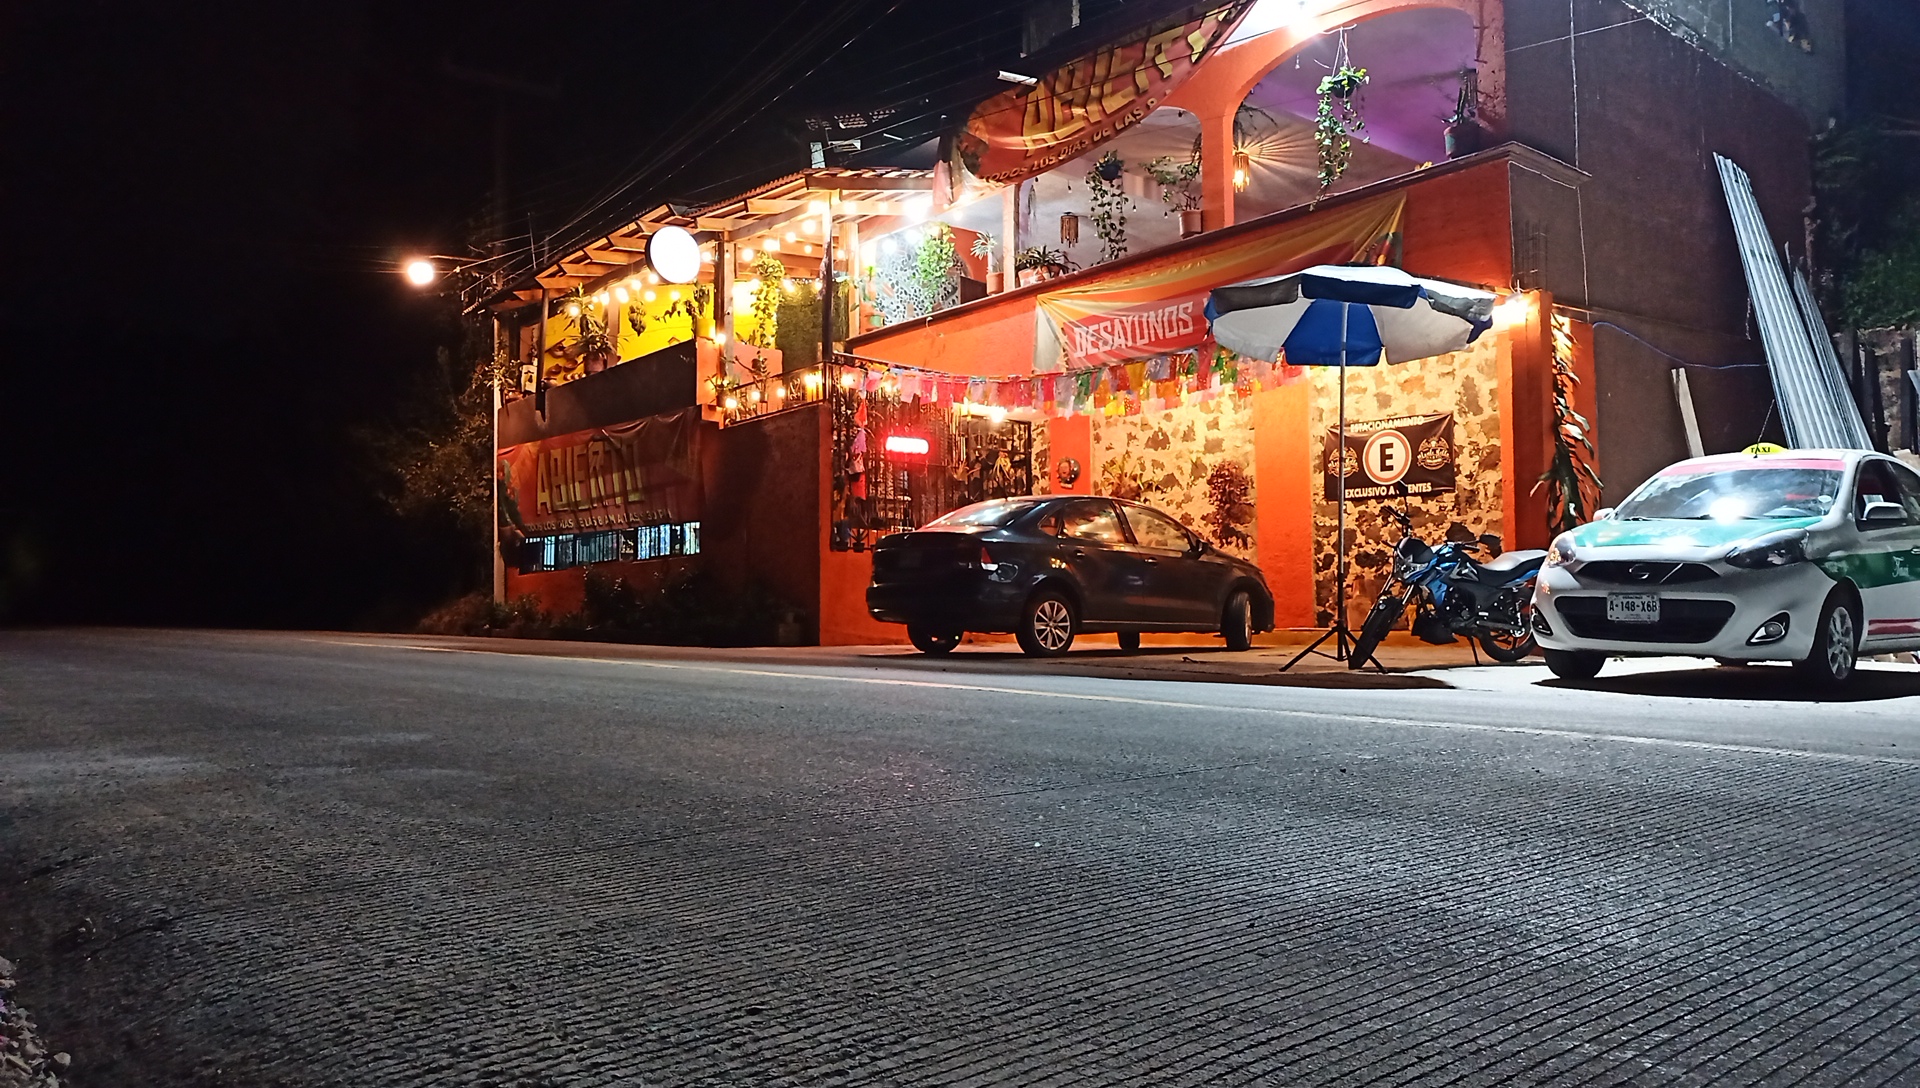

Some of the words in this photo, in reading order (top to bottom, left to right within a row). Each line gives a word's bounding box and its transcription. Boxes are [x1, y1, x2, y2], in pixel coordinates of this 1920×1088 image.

[1032, 154, 1058, 171] LOS
[1115, 107, 1144, 131] LAS
[1073, 301, 1194, 358] DESAYUNOS
[1380, 443, 1394, 472] E
[1750, 446, 1771, 454] TAXI
[537, 440, 644, 516] ABIERTO
[1345, 486, 1387, 498] EXCLUSIVO
[1388, 486, 1395, 496] A
